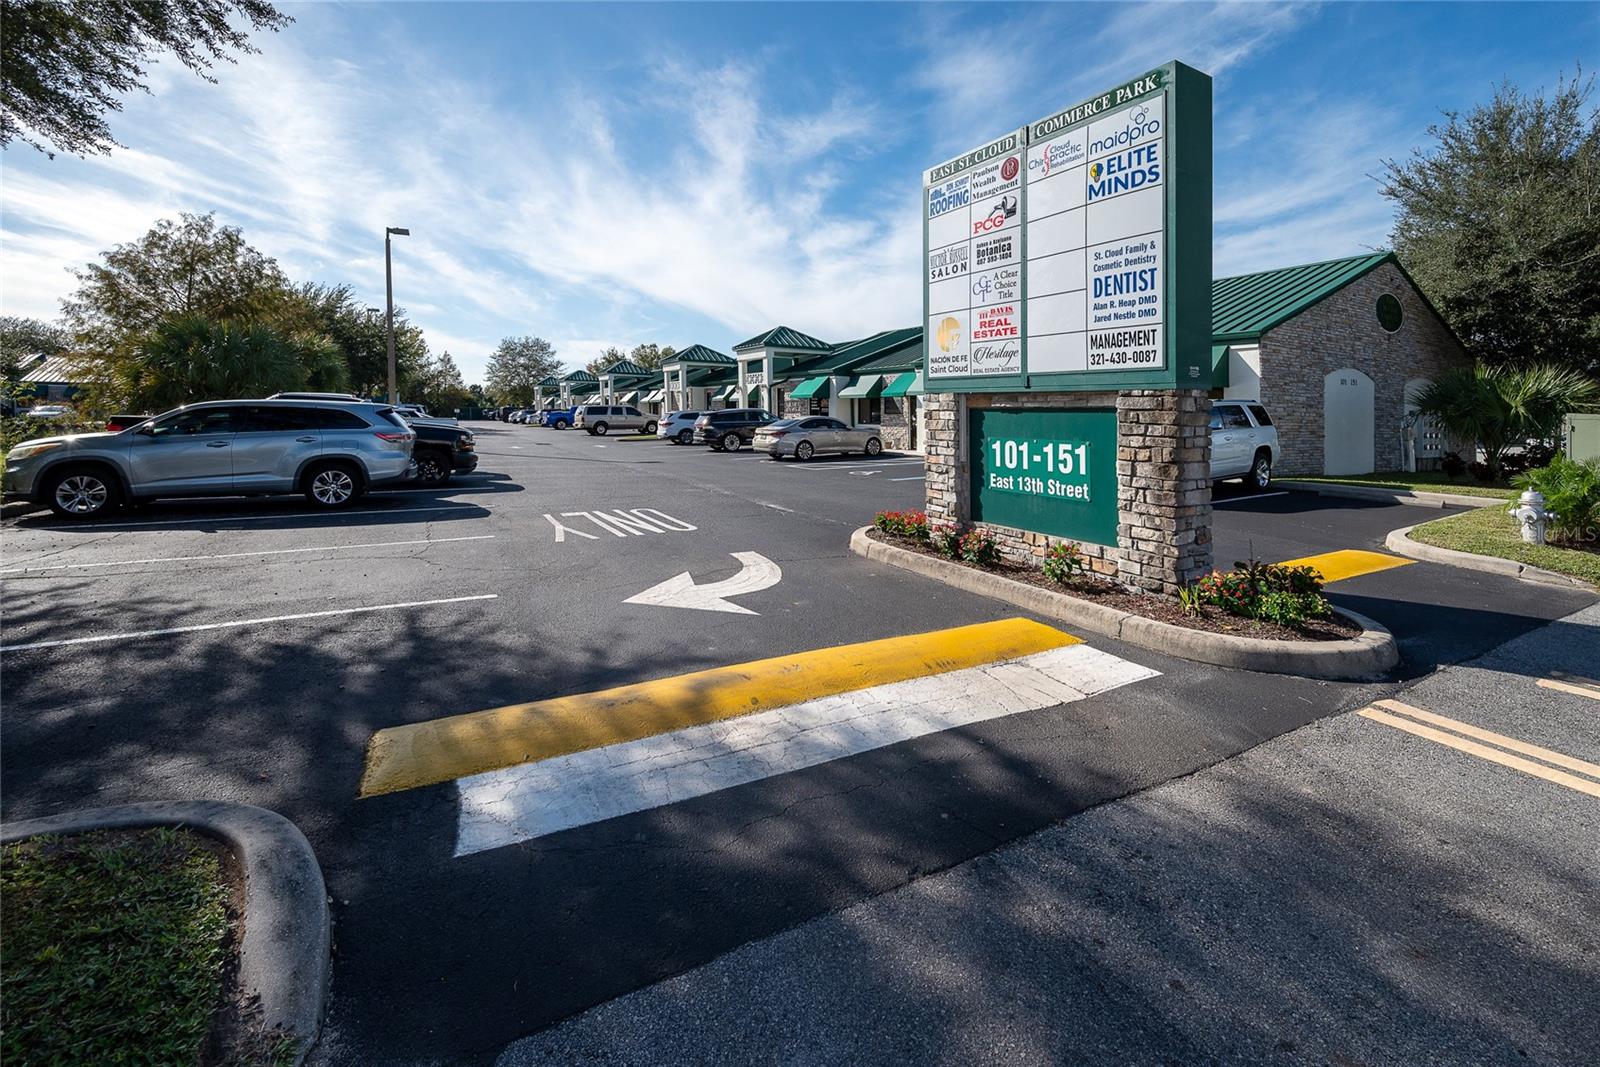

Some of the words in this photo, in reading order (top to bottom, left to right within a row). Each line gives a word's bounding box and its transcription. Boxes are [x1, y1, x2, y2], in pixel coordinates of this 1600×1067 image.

[1036, 95, 1111, 137] COMMERCE
[1116, 74, 1156, 103] PARK
[1050, 140, 1070, 153] Cloud
[1090, 120, 1160, 155] maidpro
[931, 162, 956, 180] EAST
[959, 158, 972, 170] ST.
[975, 138, 1013, 162] CLOUD
[1051, 152, 1085, 169] Rehabilitation
[1107, 143, 1158, 176] ELITE
[973, 164, 999, 179] Paulson
[973, 176, 996, 189] Wealth
[973, 179, 1018, 200] Management
[1088, 164, 1160, 201] MINDS
[930, 189, 969, 217] ROOFING
[974, 214, 1004, 234] PCG
[977, 242, 1012, 259] Botanica
[1094, 251, 1103, 261] St.
[1104, 247, 1123, 259] Cloud
[1125, 242, 1148, 255] Family
[1150, 240, 1156, 250] &
[931, 261, 968, 280] SALON
[1093, 259, 1122, 272] Cosmetic
[1124, 254, 1157, 268] Dentistry
[994, 272, 999, 280] A
[1000, 270, 1018, 279] Clear
[1093, 267, 1157, 298] DENTIST
[994, 280, 1017, 290] Choice
[998, 290, 1013, 300] Title
[1093, 302, 1108, 311] Alan
[1109, 300, 1117, 309] R.
[1118, 299, 1136, 308] Heap
[1138, 295, 1157, 305] DMD
[980, 318, 1011, 329] REAL
[1093, 314, 1112, 323] Jared
[1113, 311, 1136, 321] Nestle
[1138, 307, 1157, 318] DMD
[974, 326, 1018, 339] ESTATE
[1090, 329, 1157, 350] MANAGEMENT
[930, 355, 951, 364] NACIÓN
[952, 355, 960, 363] DE
[961, 354, 968, 362] FE
[973, 340, 1020, 367] Heritage
[1090, 350, 1157, 366] 321-430-0087
[930, 366, 947, 374] Saint
[948, 364, 968, 373] Cloud
[992, 440, 1086, 475] 101-151
[990, 473, 1014, 490] East
[1017, 476, 1044, 493] 13th
[1047, 479, 1089, 500] Street
[543, 508, 698, 542] ONLY
